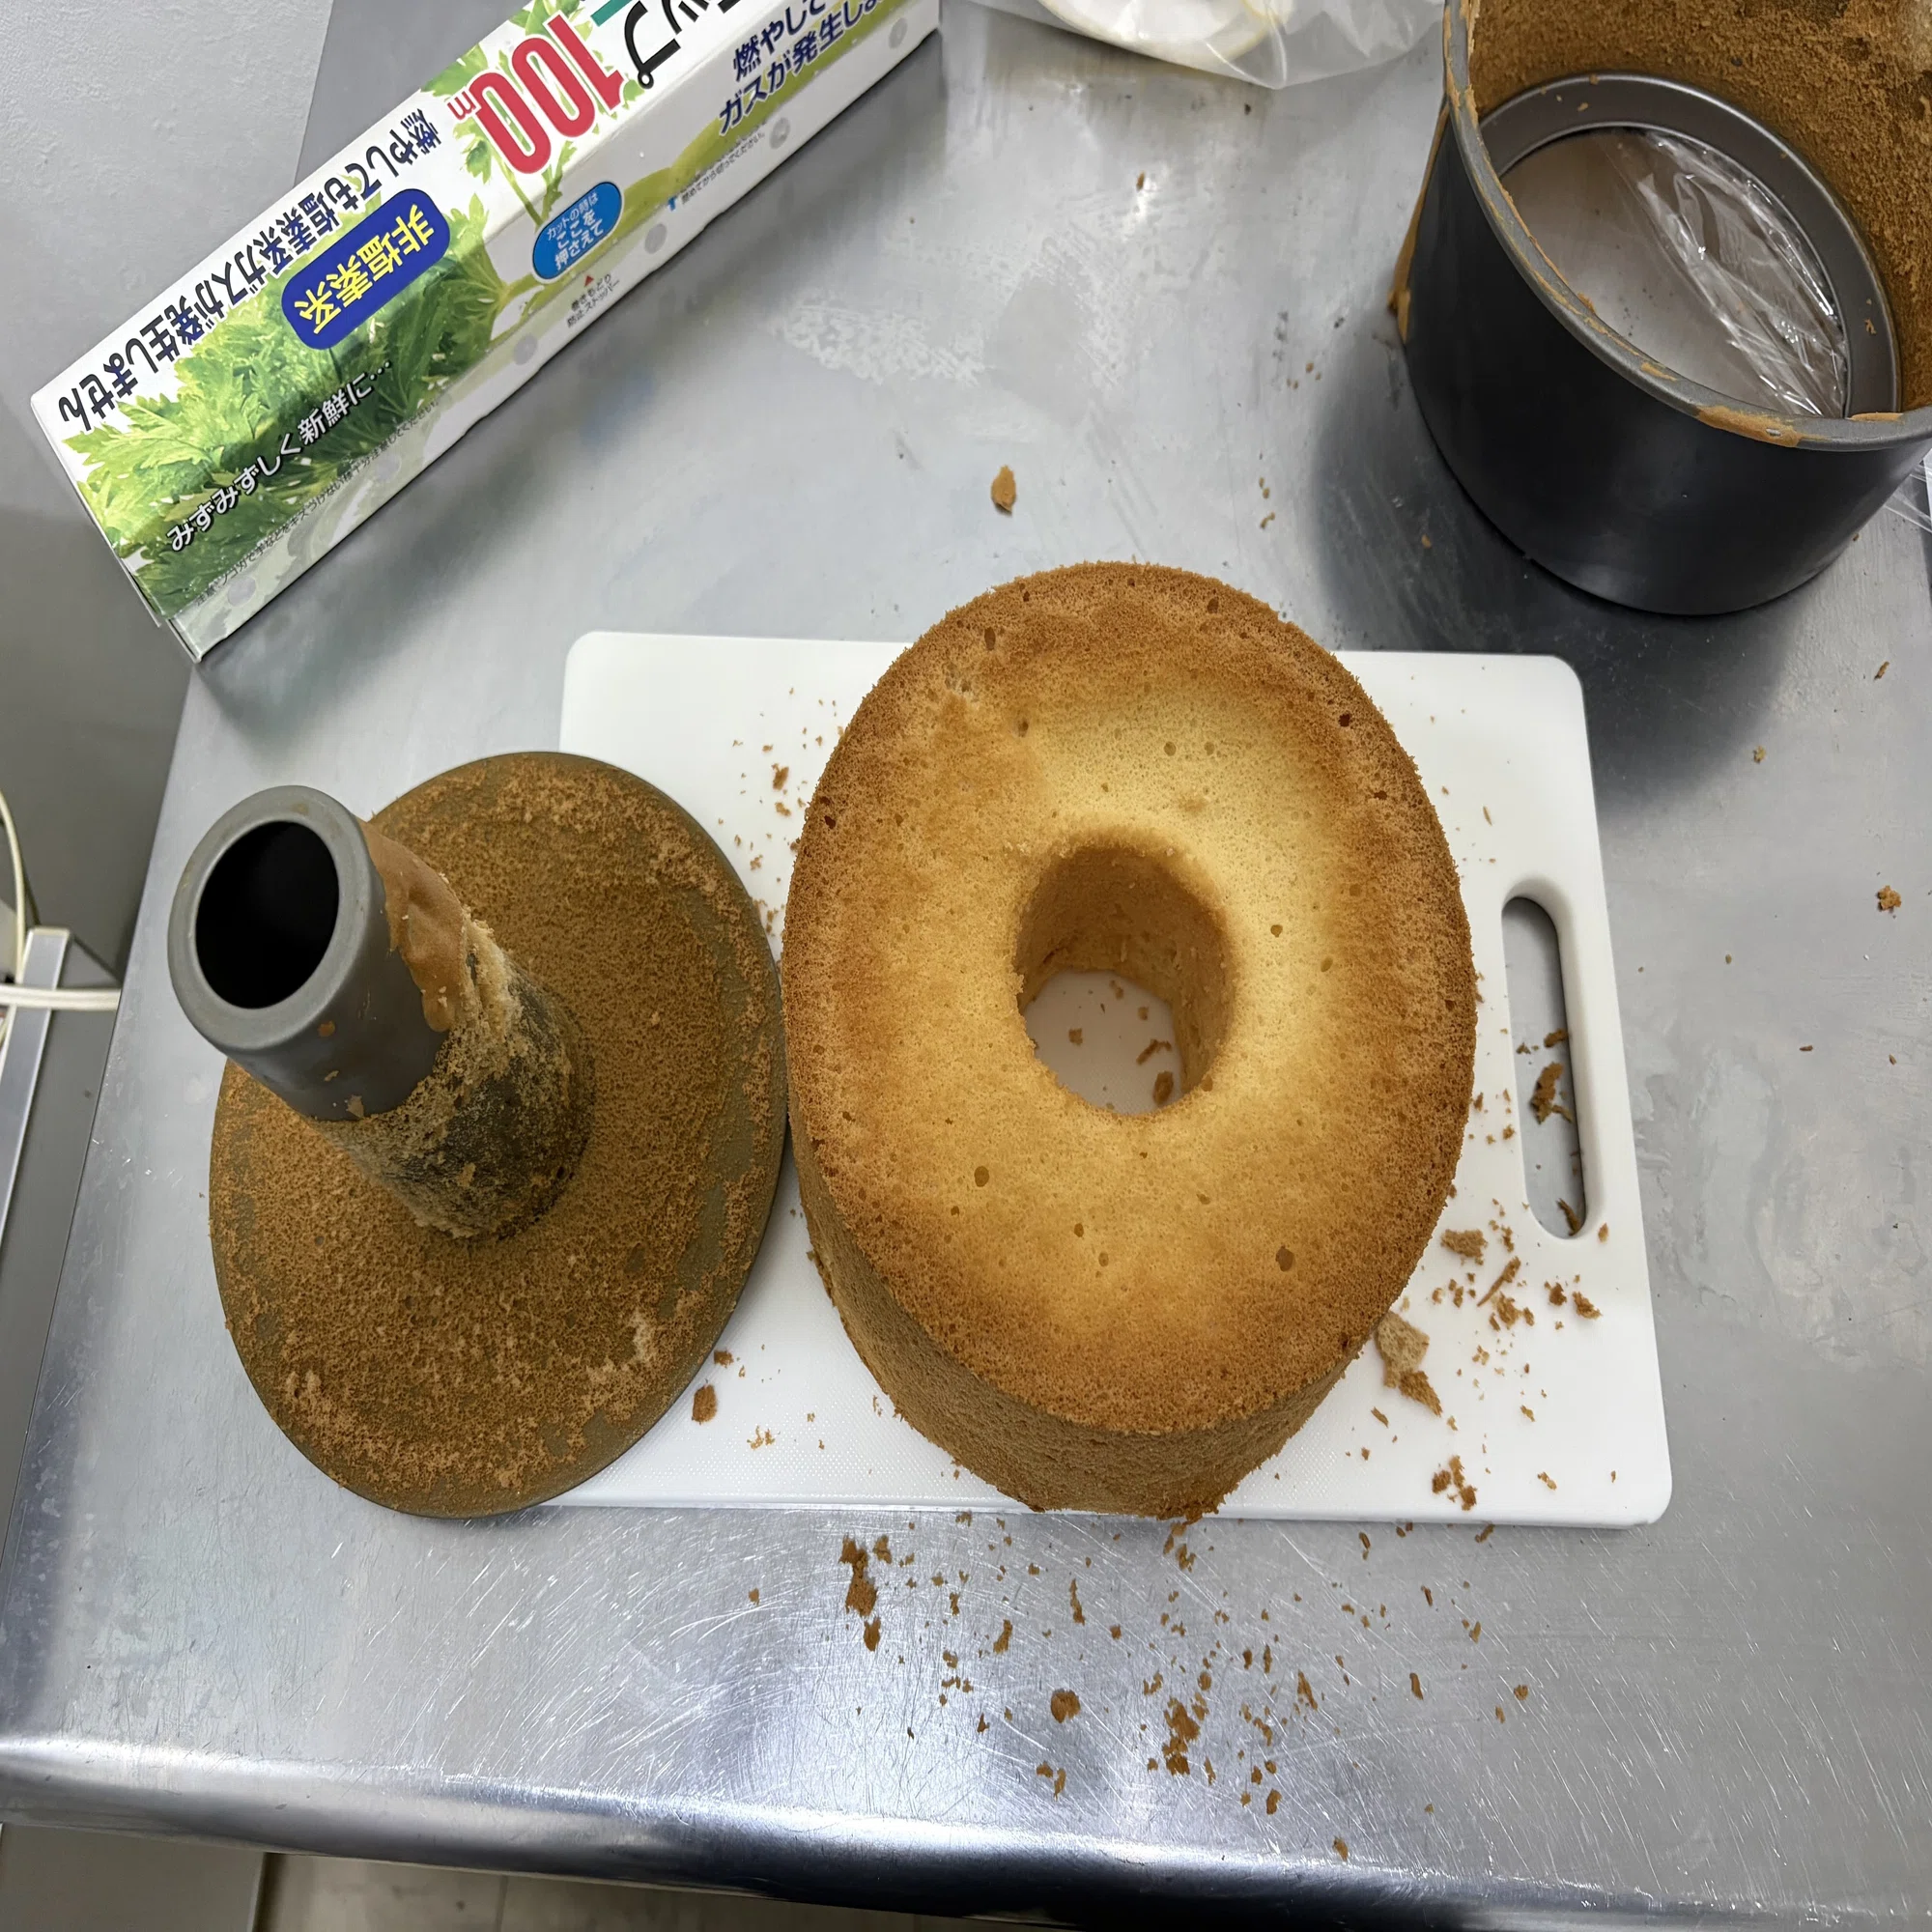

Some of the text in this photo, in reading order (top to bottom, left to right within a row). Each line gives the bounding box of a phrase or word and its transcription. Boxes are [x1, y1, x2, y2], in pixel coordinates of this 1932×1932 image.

[624, 0, 741, 89] ップ
[547, 191, 599, 241] カットの時は
[554, 218, 604, 271] 押さえて
[555, 210, 596, 250] ここを
[58, 108, 441, 431] 燃やしても塩素系ガスが発生しません
[294, 204, 435, 334] 非塩素系
